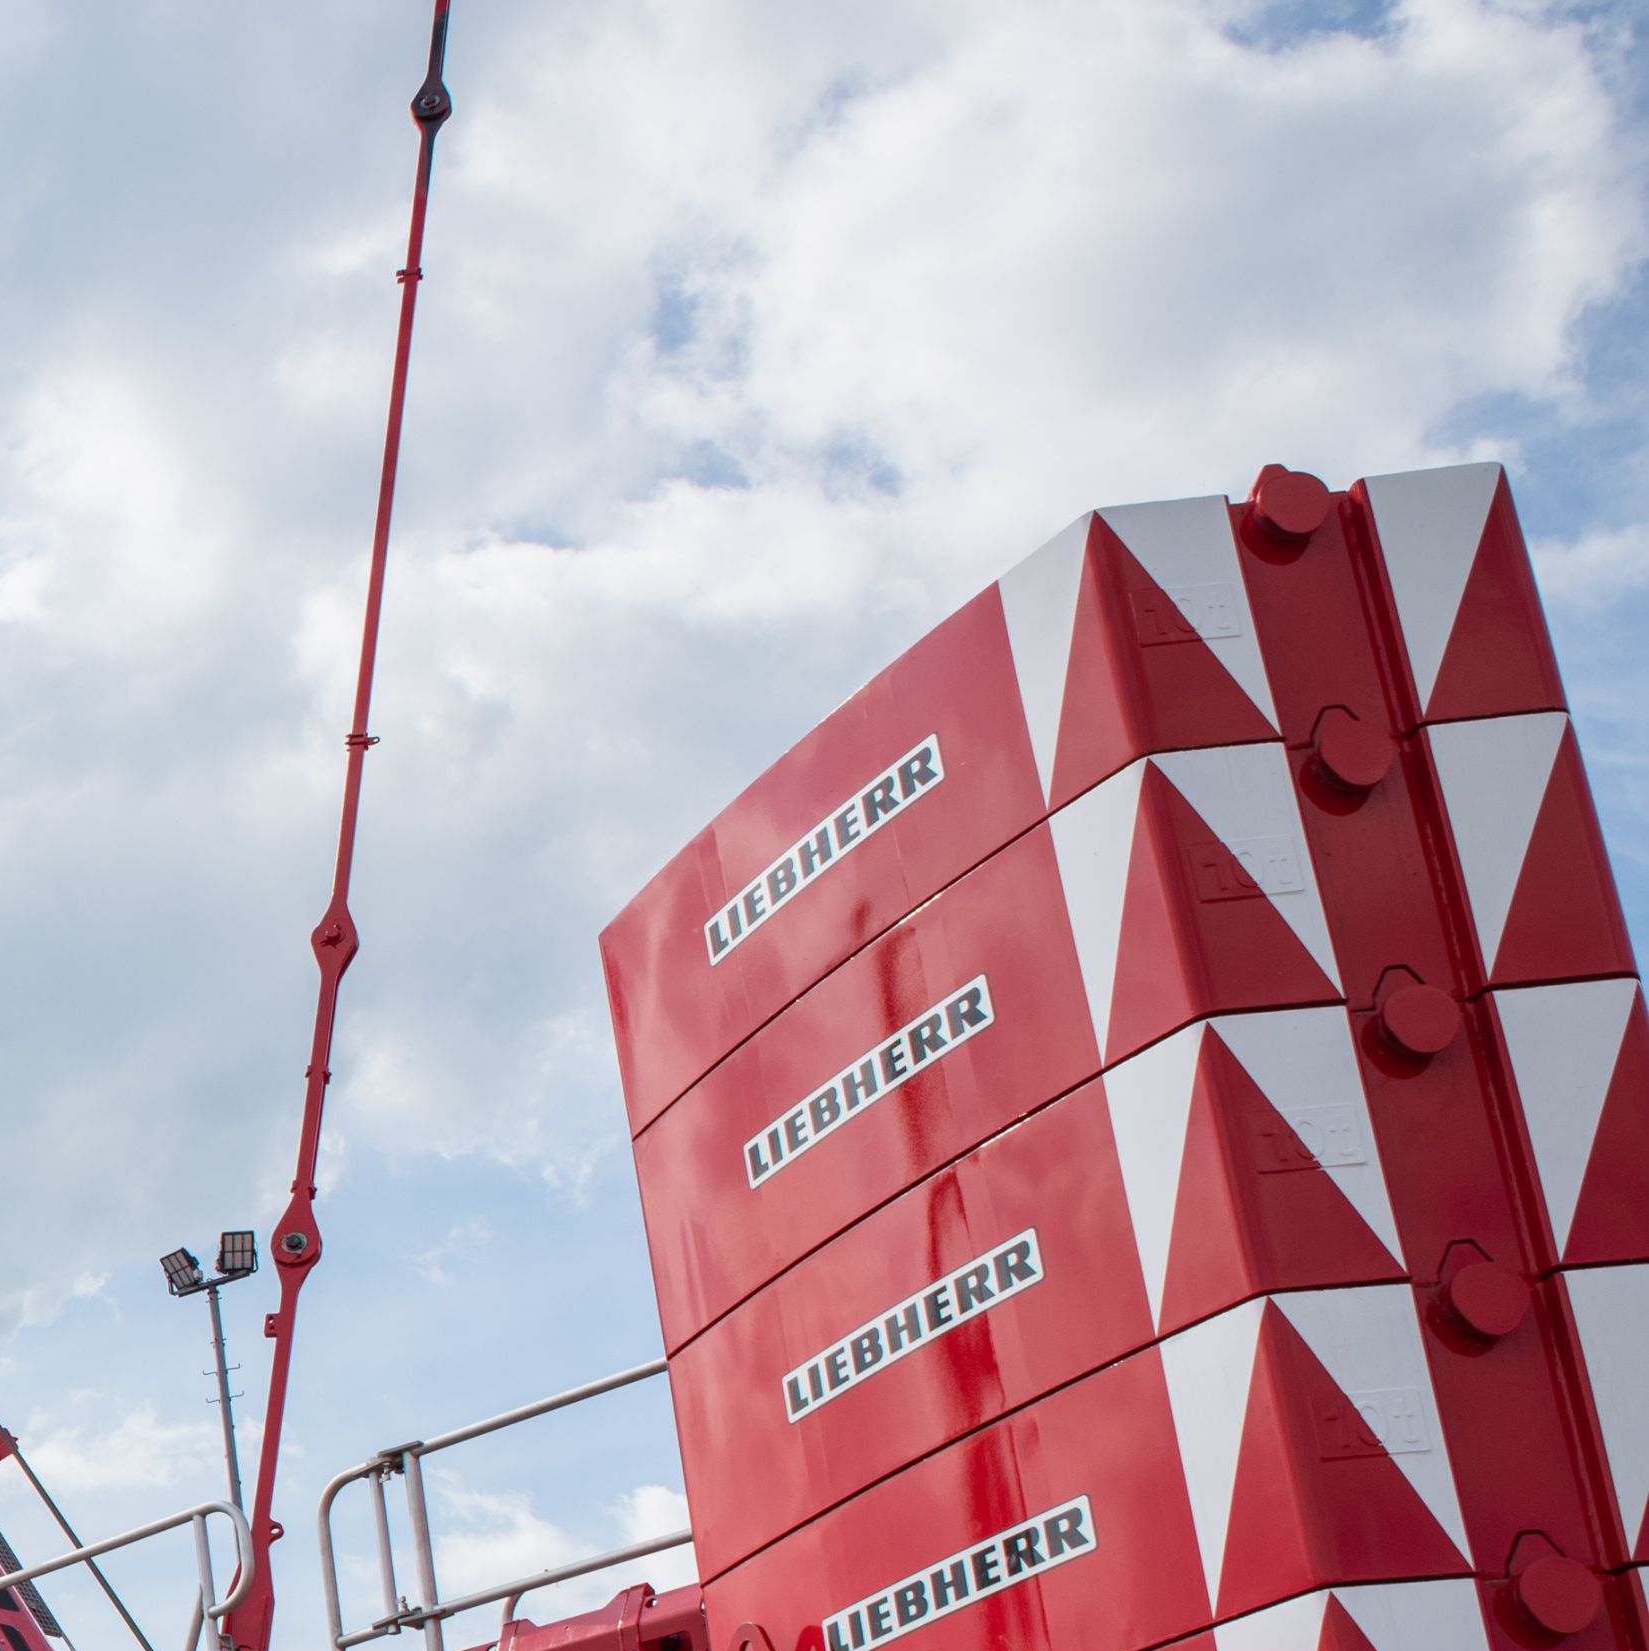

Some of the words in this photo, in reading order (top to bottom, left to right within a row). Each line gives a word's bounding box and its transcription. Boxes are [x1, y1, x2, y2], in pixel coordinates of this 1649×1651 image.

[709, 745, 940, 958] LIEBHERR
[747, 985, 990, 1181] LIEBHERR
[786, 1239, 1038, 1416] LIEBHERR
